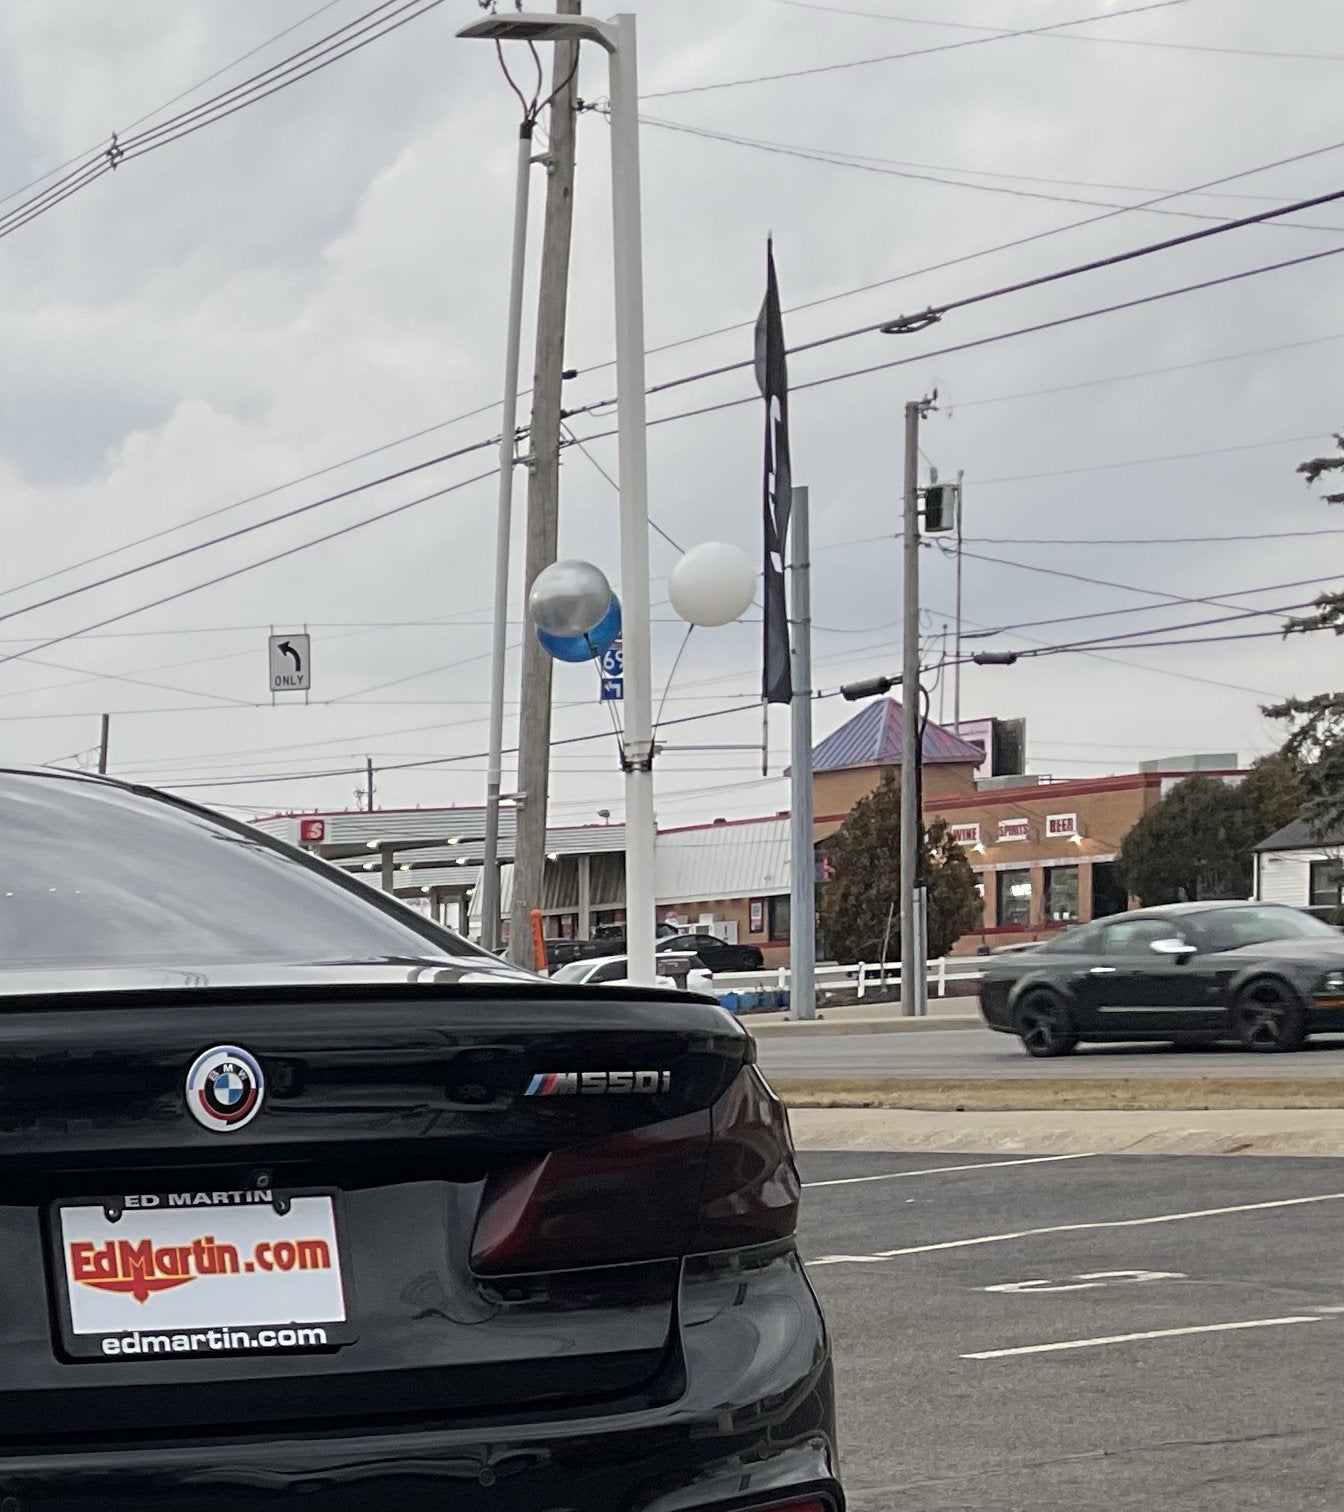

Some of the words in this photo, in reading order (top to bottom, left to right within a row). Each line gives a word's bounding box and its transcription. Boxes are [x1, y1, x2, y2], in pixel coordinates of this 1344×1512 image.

[274, 675, 304, 687] ONLY
[952, 828, 977, 841] WINE
[998, 824, 1029, 837] SPIRITS
[1050, 818, 1074, 832] BEER
[207, 1063, 248, 1082] BMW
[550, 1071, 671, 1094] M550i
[124, 1194, 160, 1209] ED
[168, 1189, 273, 1207] MARTIN
[70, 1236, 332, 1285] EdMartin.com
[100, 1327, 327, 1356] edmartin.com
